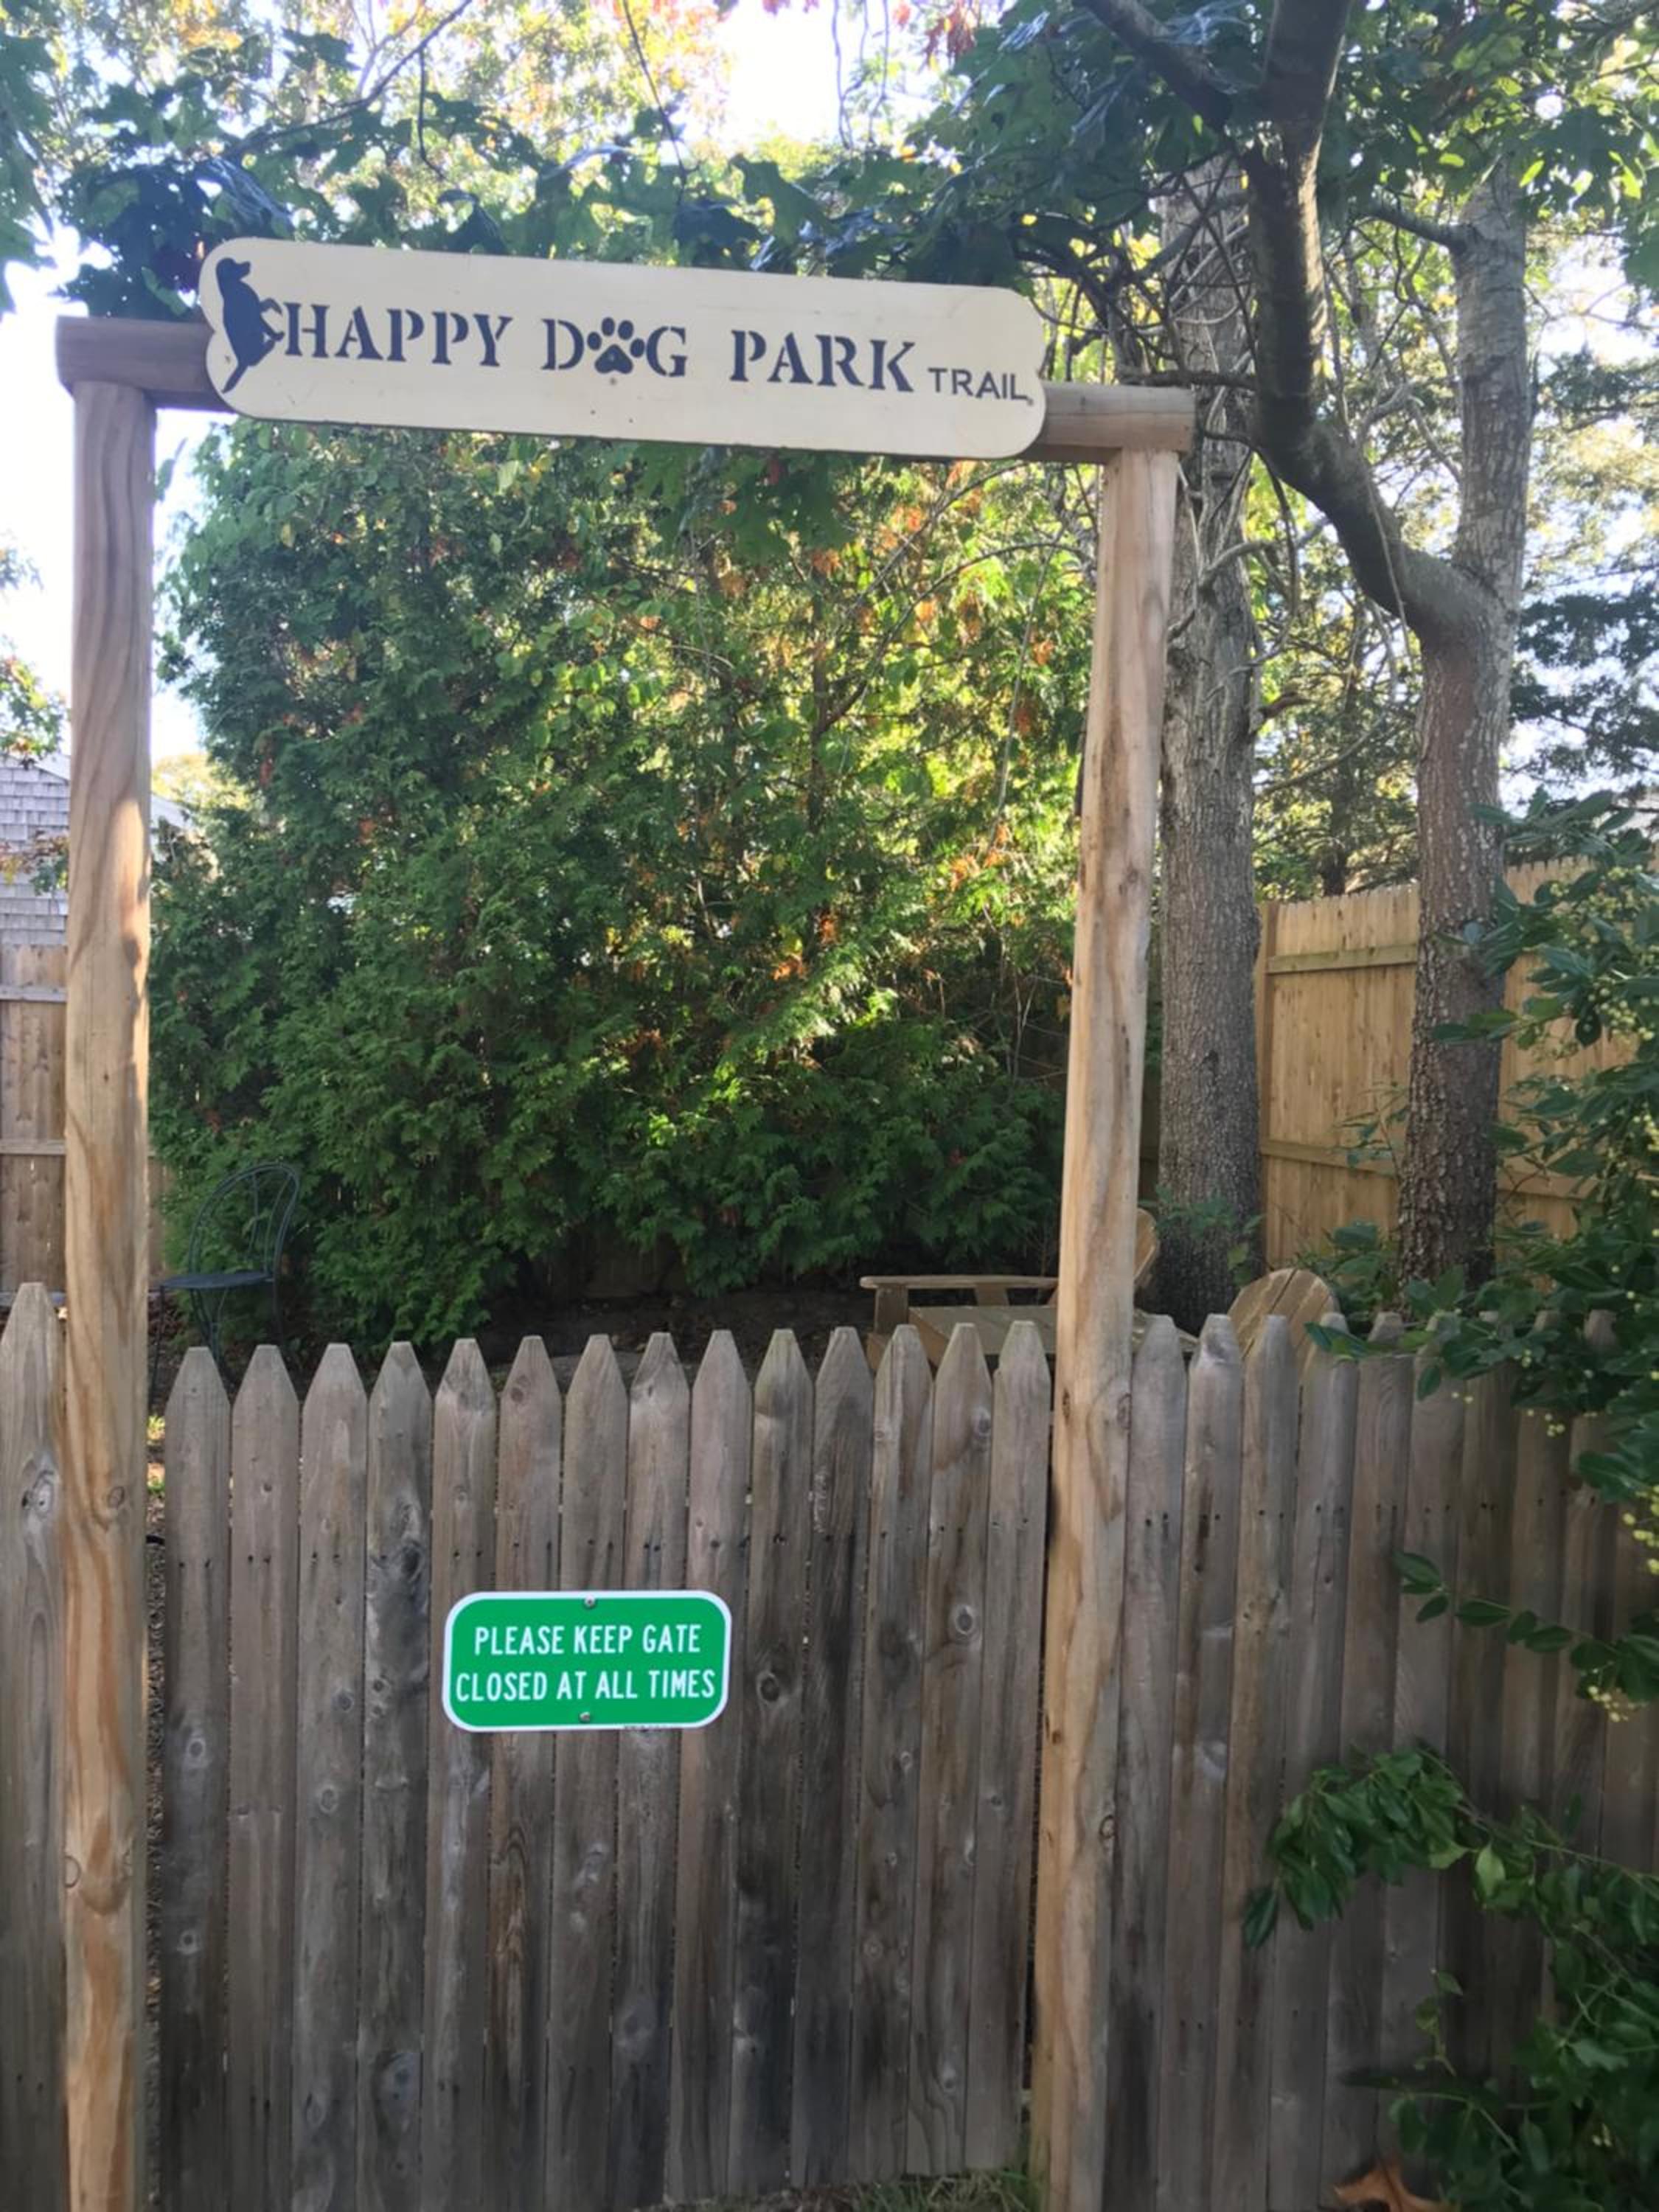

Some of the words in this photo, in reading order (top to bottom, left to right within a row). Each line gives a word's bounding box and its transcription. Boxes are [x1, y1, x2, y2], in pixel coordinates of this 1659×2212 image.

[284, 302, 512, 366] HAPPY
[731, 330, 915, 392] PARK
[928, 368, 1029, 400] TRAIL
[475, 1626, 564, 1655] PLEASE
[574, 1625, 632, 1654] KEEP
[642, 1624, 701, 1653] GATE
[456, 1672, 547, 1702] CLOSED
[557, 1671, 587, 1700] AT
[595, 1671, 638, 1699] ALL
[649, 1669, 715, 1698] TIMES
